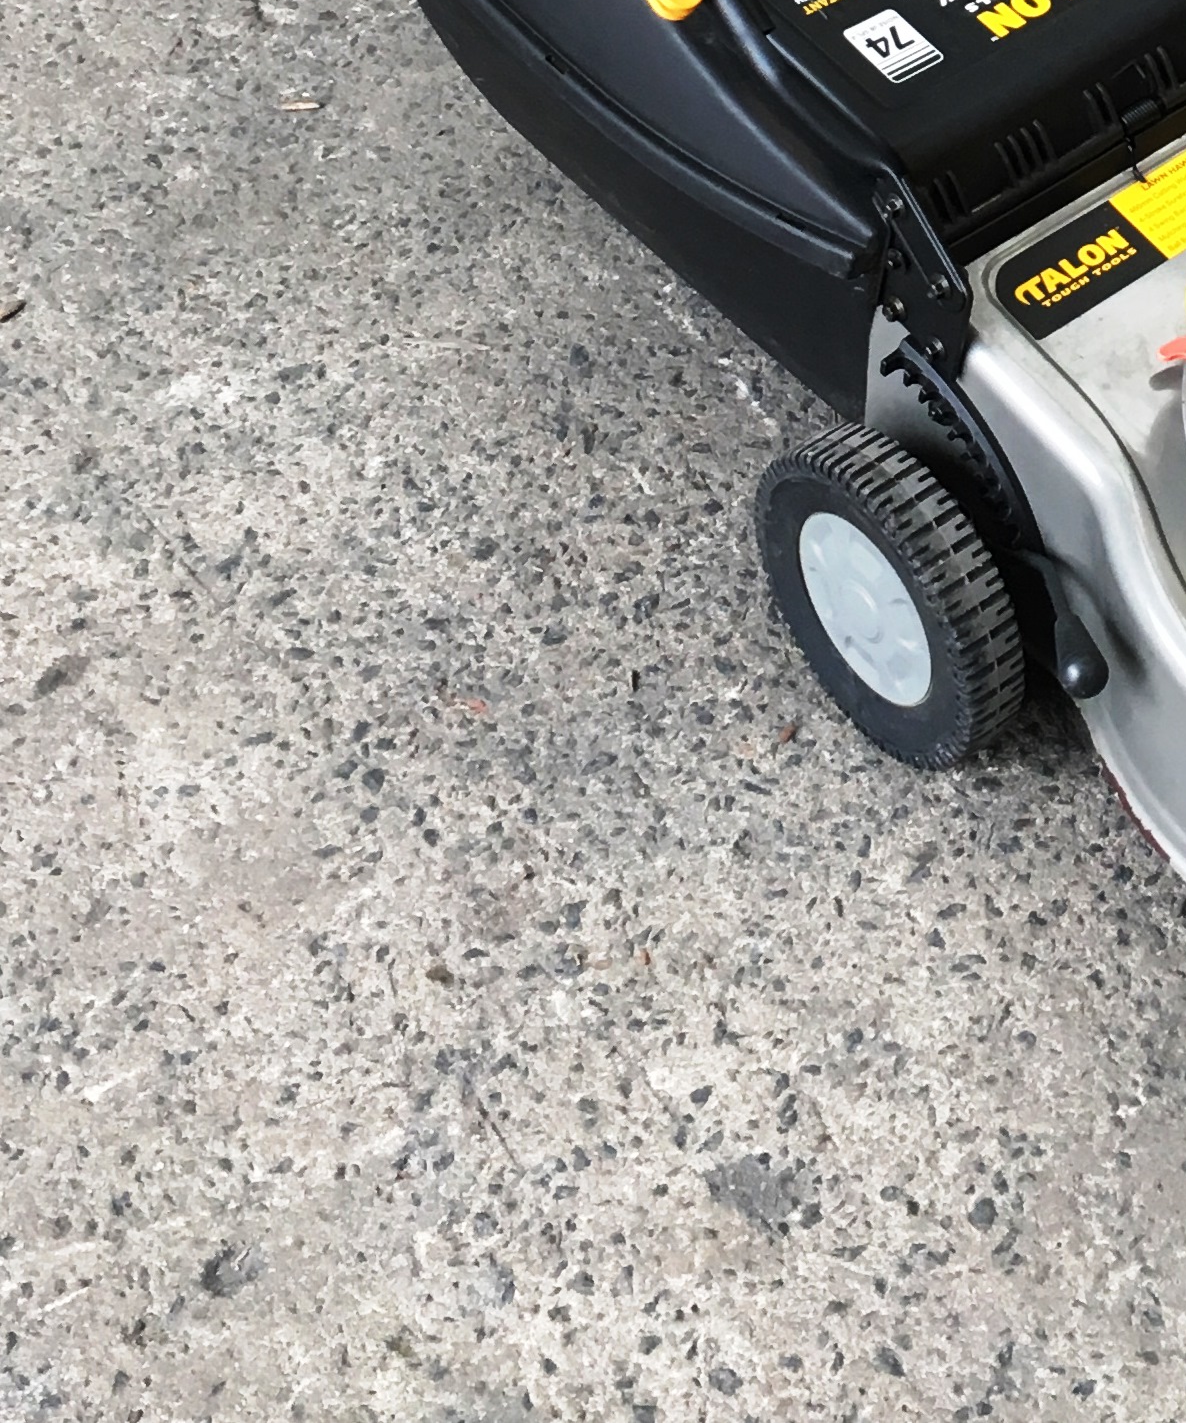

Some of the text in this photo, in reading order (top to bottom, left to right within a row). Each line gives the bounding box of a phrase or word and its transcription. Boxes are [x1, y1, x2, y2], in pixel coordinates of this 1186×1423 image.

[864, 25, 915, 58] 74
[1141, 171, 1168, 190] LAWN
[1015, 228, 1129, 305] TALON
[1041, 246, 1137, 306] TOUGH TOOLS
